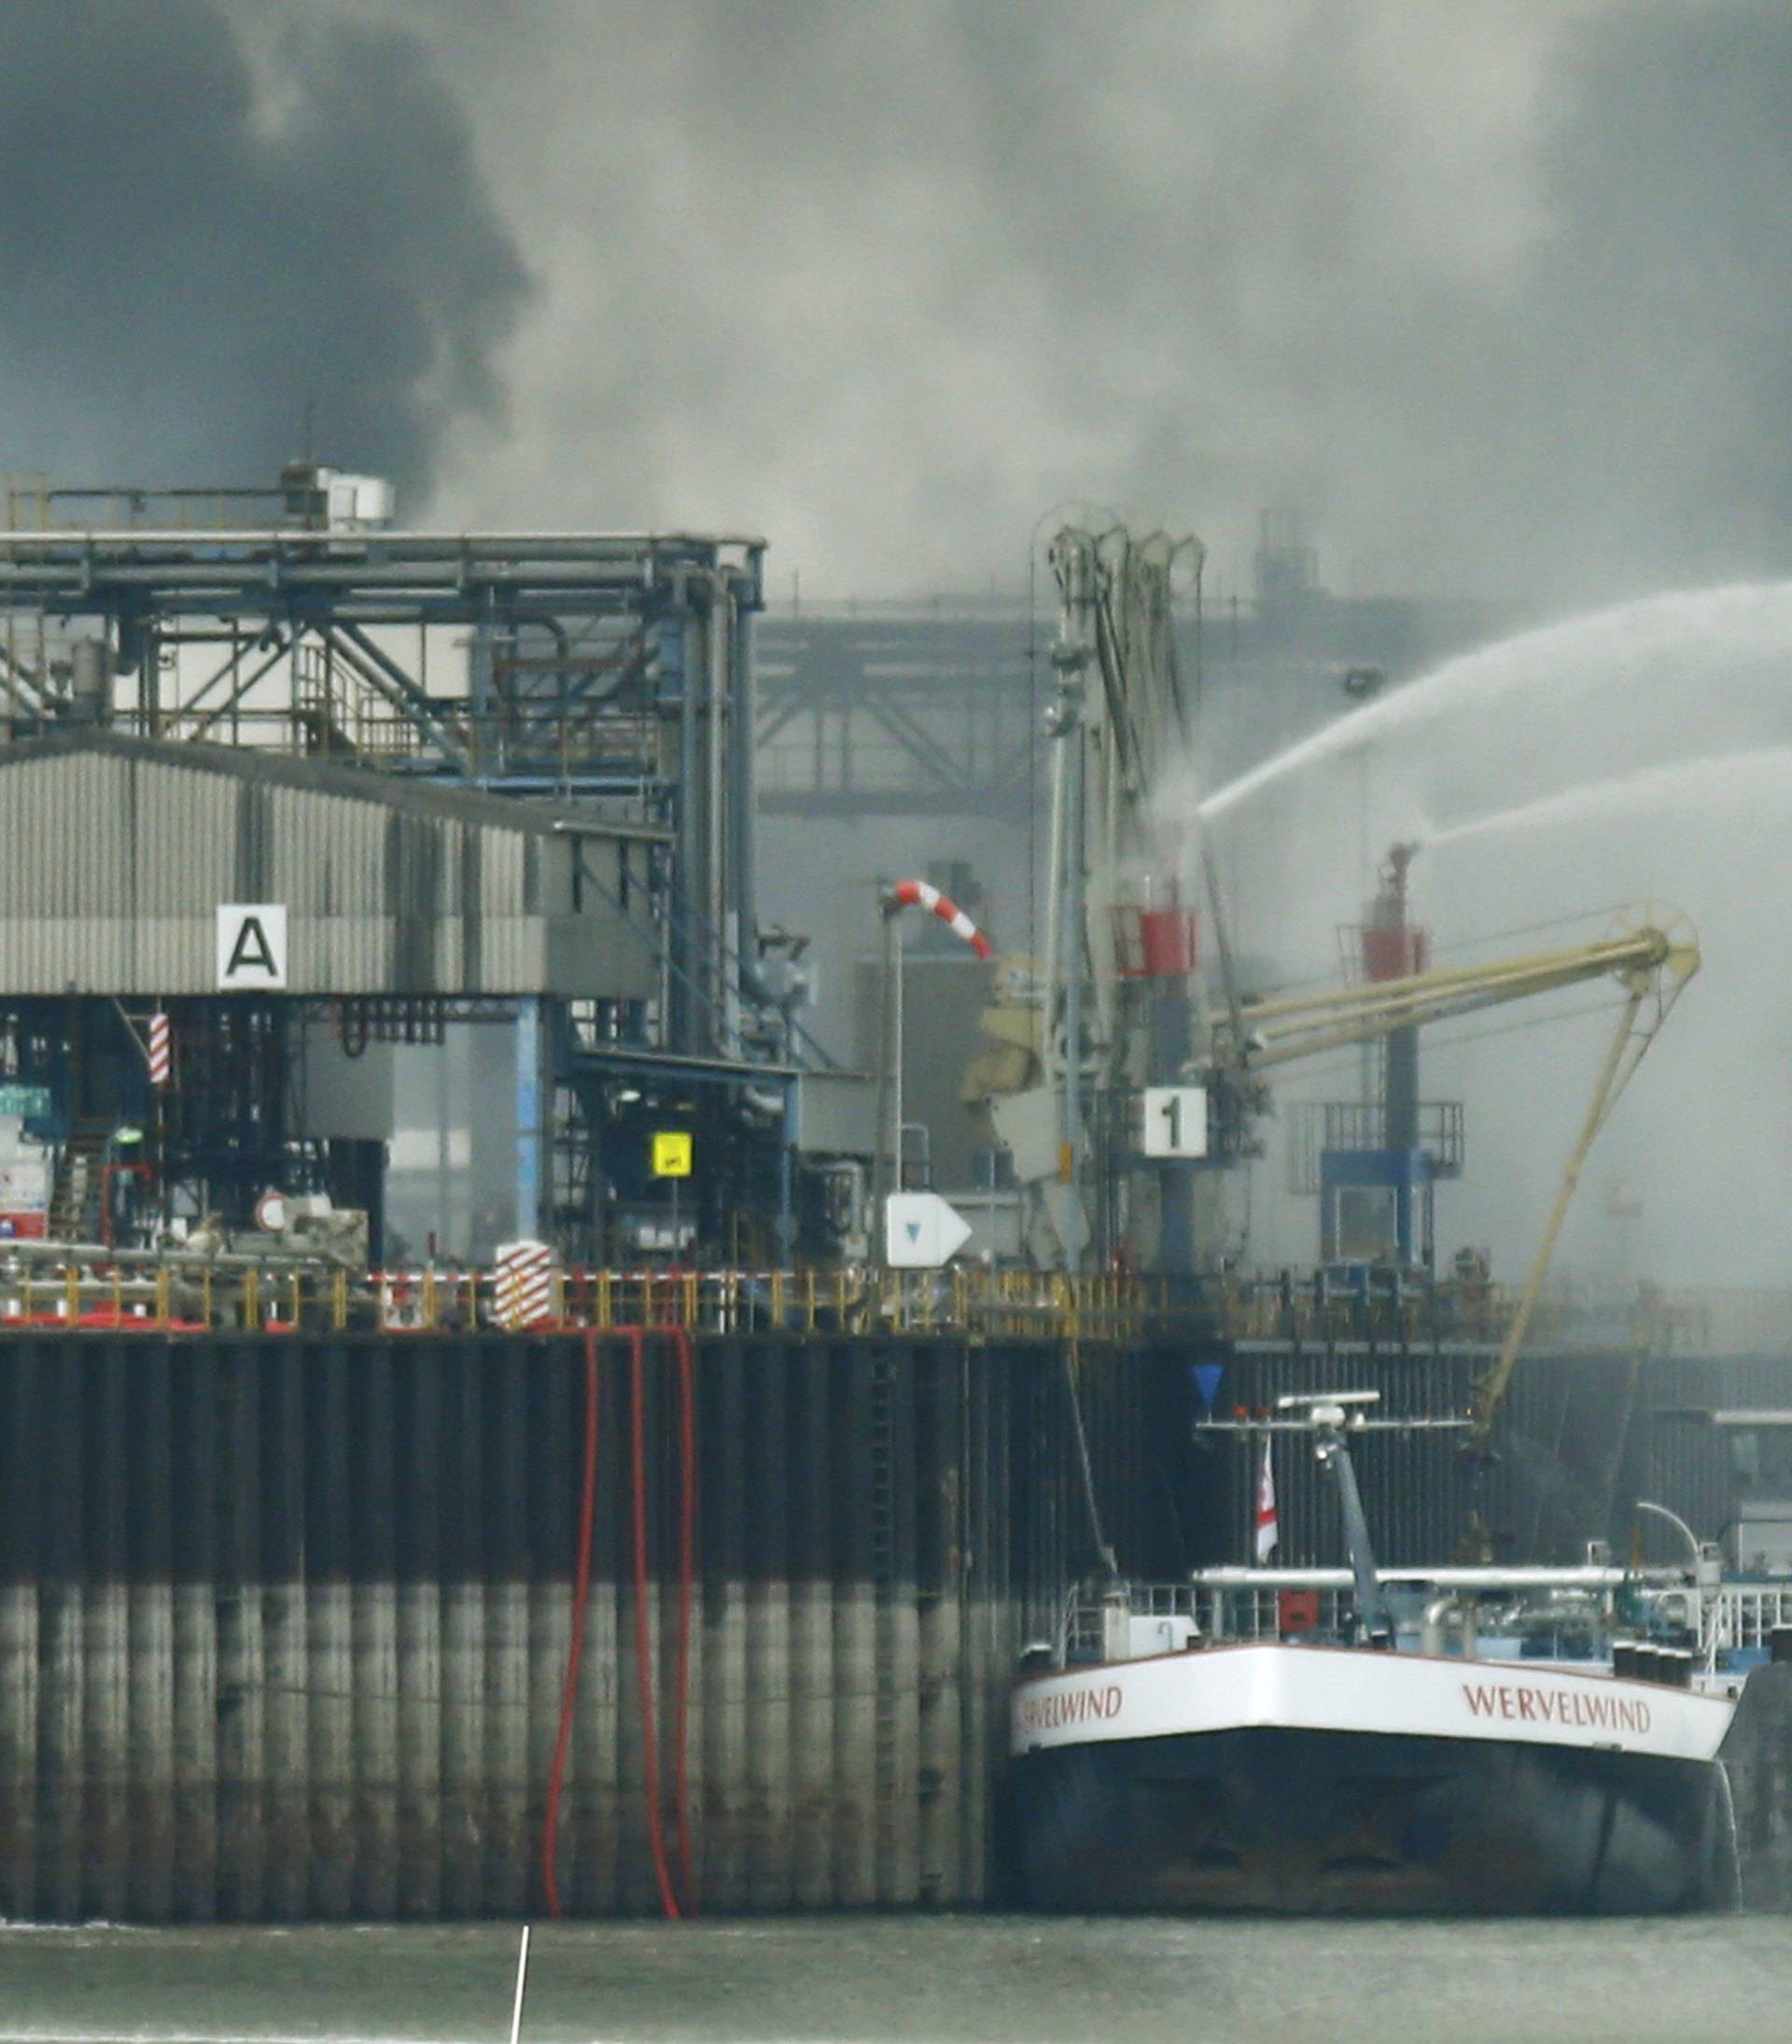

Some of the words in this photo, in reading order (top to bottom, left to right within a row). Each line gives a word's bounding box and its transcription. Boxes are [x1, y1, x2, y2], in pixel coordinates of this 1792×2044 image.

[226, 917, 278, 977] A
[1162, 1096, 1181, 1149] 1
[1463, 1685, 1651, 1733] WERVELWIND
